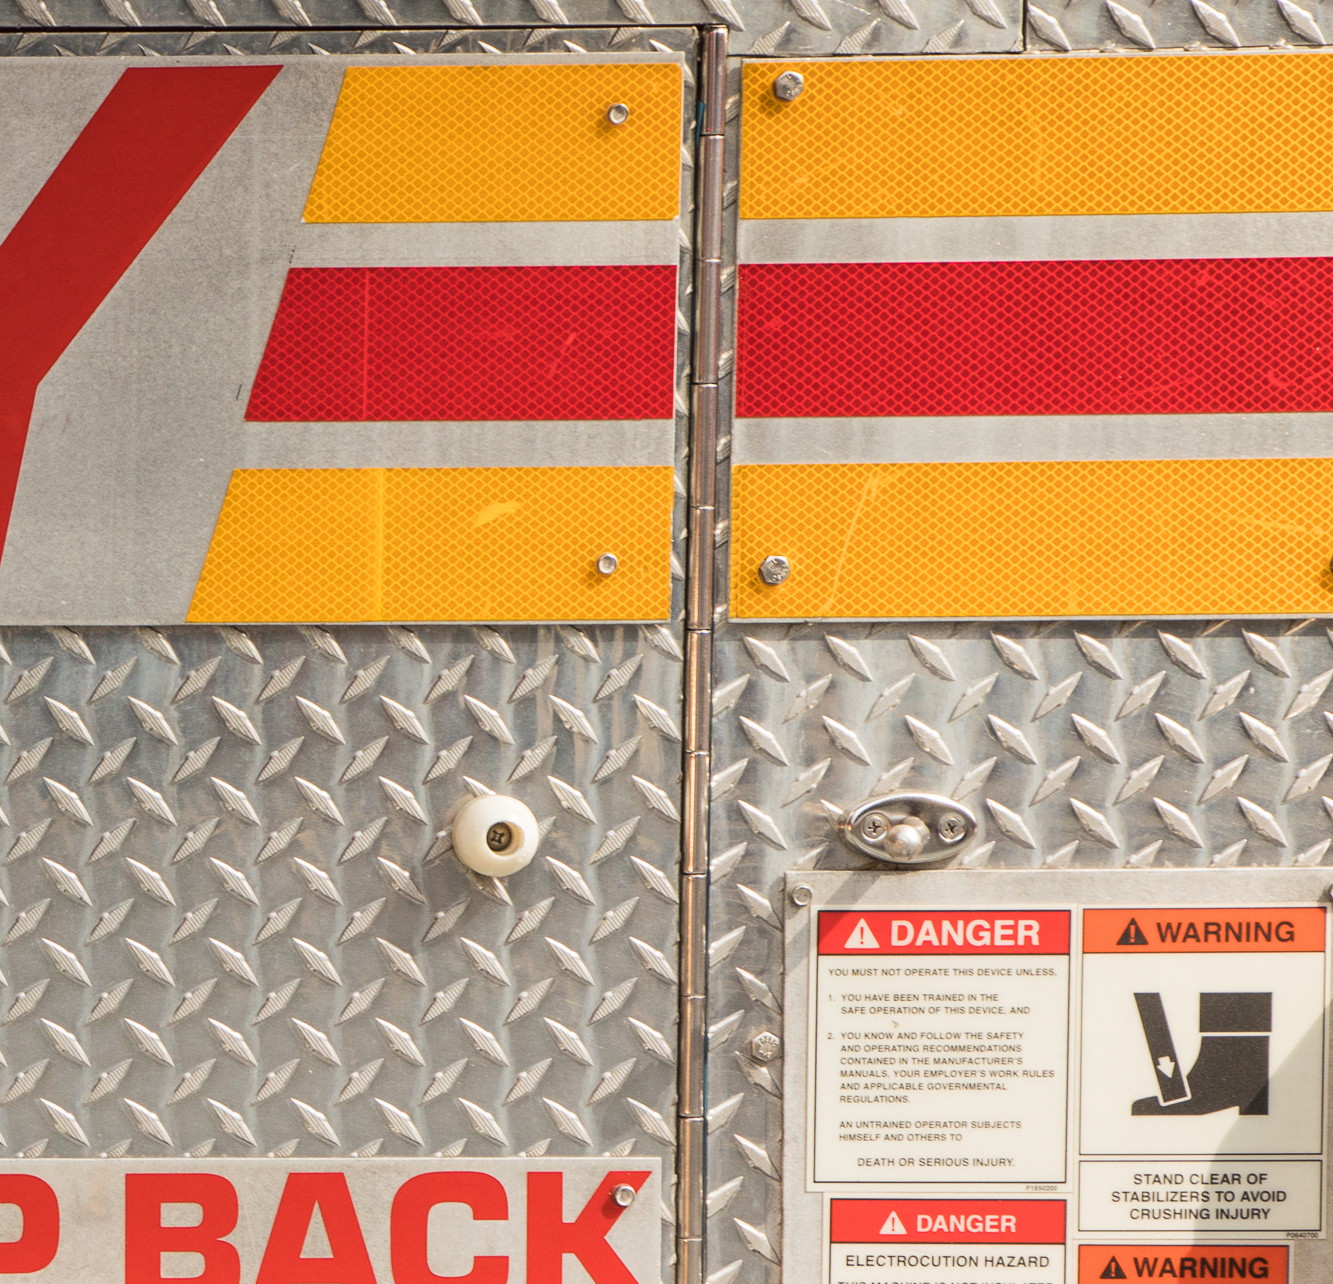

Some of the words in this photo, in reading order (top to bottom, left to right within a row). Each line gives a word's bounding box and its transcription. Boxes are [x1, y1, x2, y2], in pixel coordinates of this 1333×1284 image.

[891, 920, 1039, 946] DANGER
[1156, 921, 1294, 943] WARNING
[882, 968, 901, 976] NOT
[904, 968, 949, 976] OPERATE
[953, 968, 974, 976] THIS
[977, 968, 1012, 976] DEVICE
[858, 1158, 894, 1166] DEATH
[899, 1158, 914, 1166] OR
[919, 1158, 969, 1166] SERIOUS
[973, 1158, 1014, 1166] INJURY.
[1134, 1174, 1184, 1185] STAND
[1190, 1174, 1241, 1185] CLEAR
[1247, 1173, 1267, 1184] OF
[1112, 1191, 1210, 1202] STABILIZERS
[1215, 1191, 1235, 1202] TO
[1240, 1191, 1287, 1202] AVOID
[1130, 1208, 1210, 1220] CRUSHING
[1216, 1208, 1270, 1220] INJURY
[917, 1215, 1016, 1232] DANGER
[846, 1255, 978, 1267] ELECTROCUTION
[985, 1256, 1049, 1267] HAZARD
[1133, 1256, 1269, 1279] WARNING
